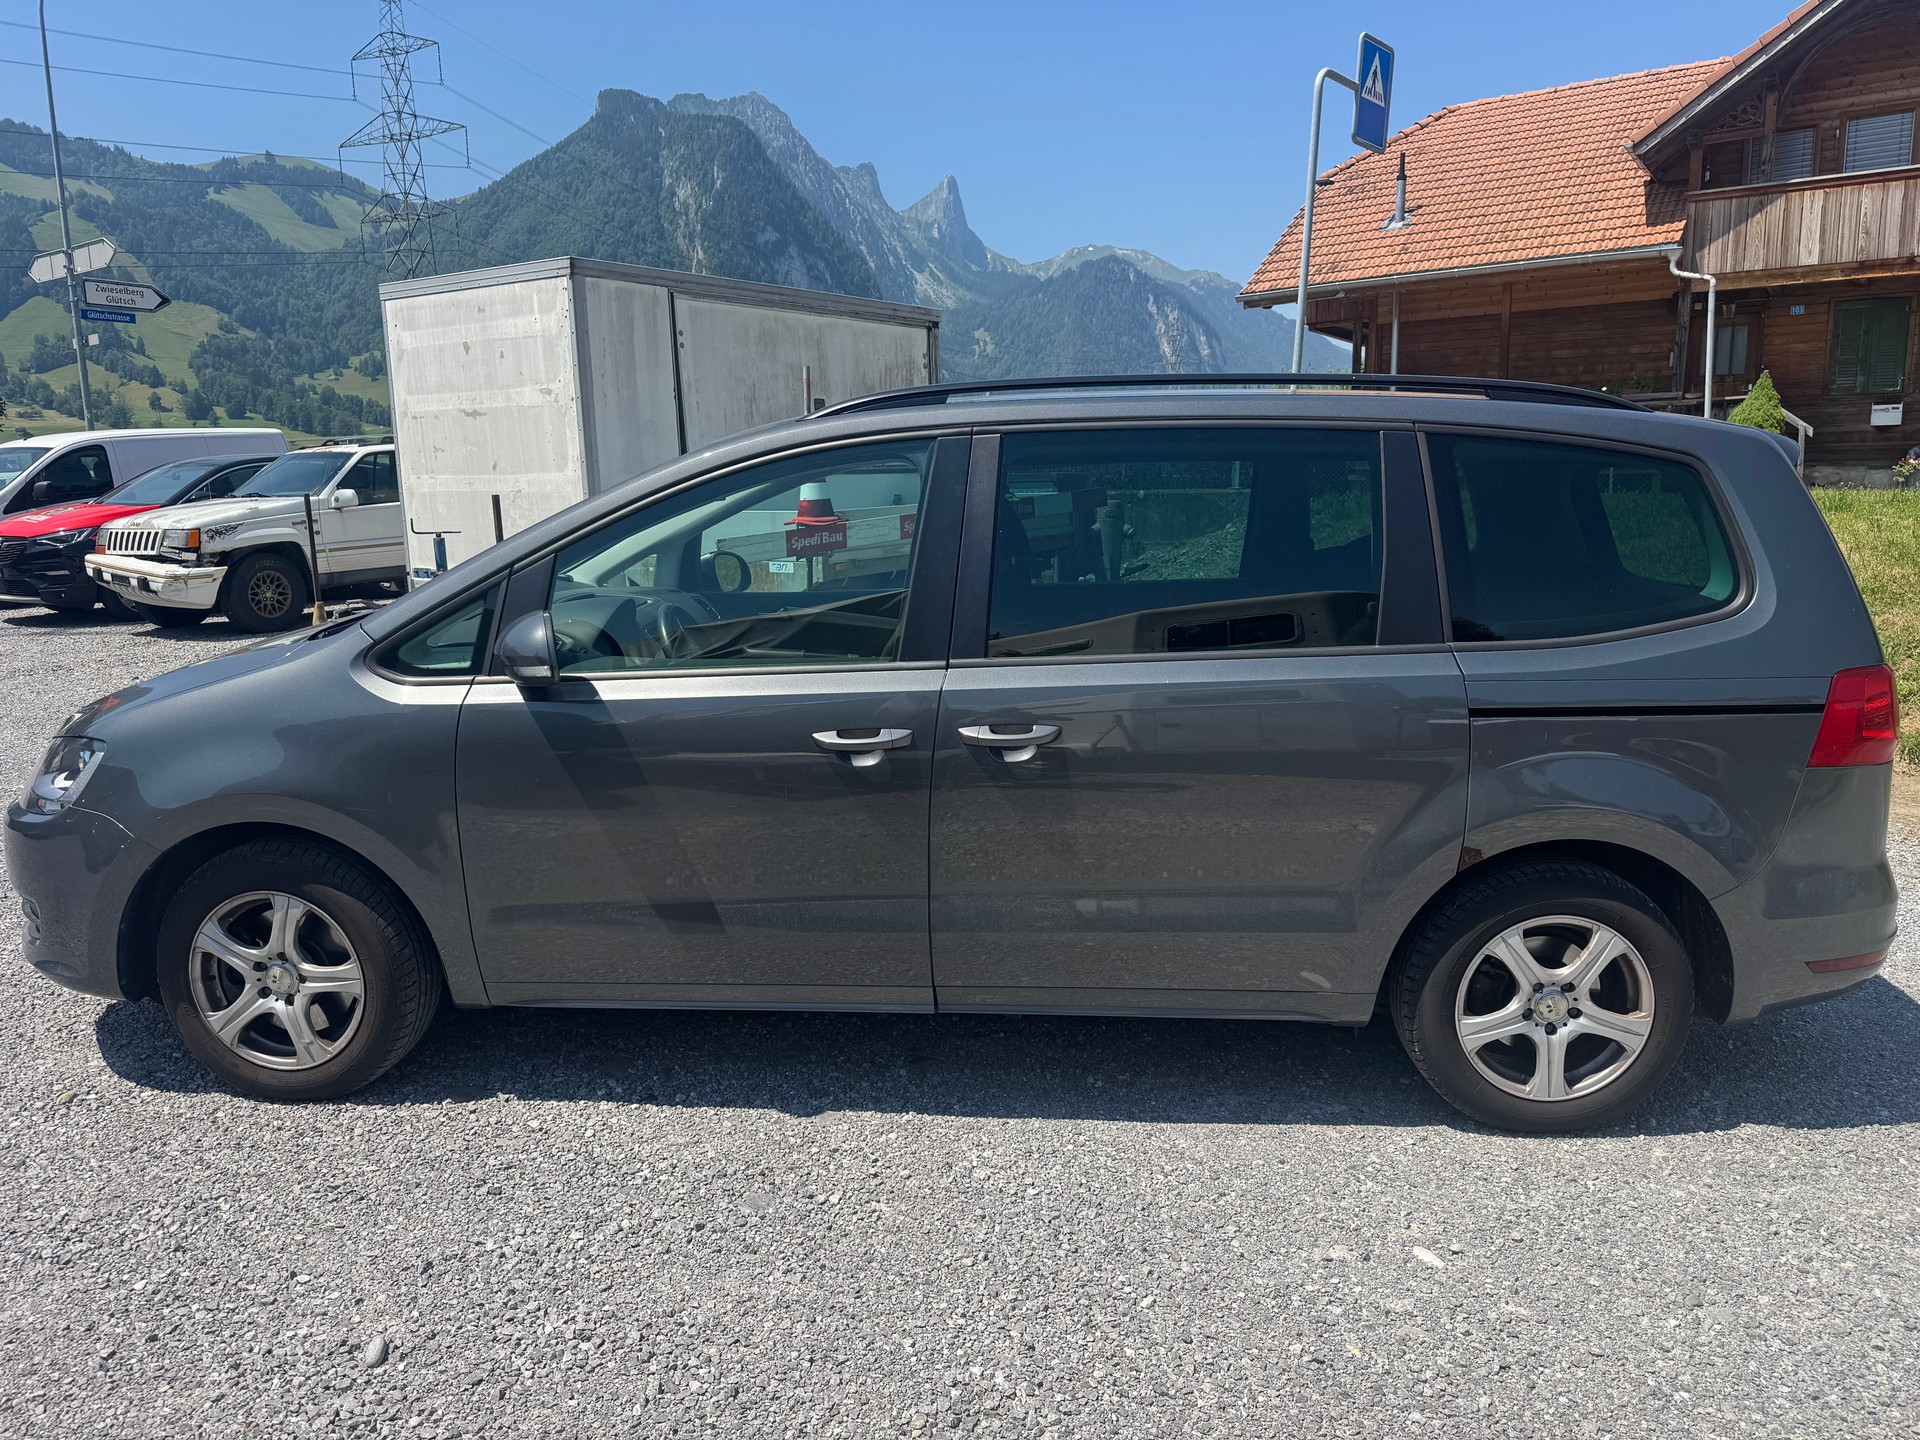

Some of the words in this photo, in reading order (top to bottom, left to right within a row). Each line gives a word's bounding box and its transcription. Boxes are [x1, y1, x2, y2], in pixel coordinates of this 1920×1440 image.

[95, 284, 144, 298] Zwieselberg
[106, 295, 136, 306] Glütsch
[87, 311, 131, 321] Glütschstrasse
